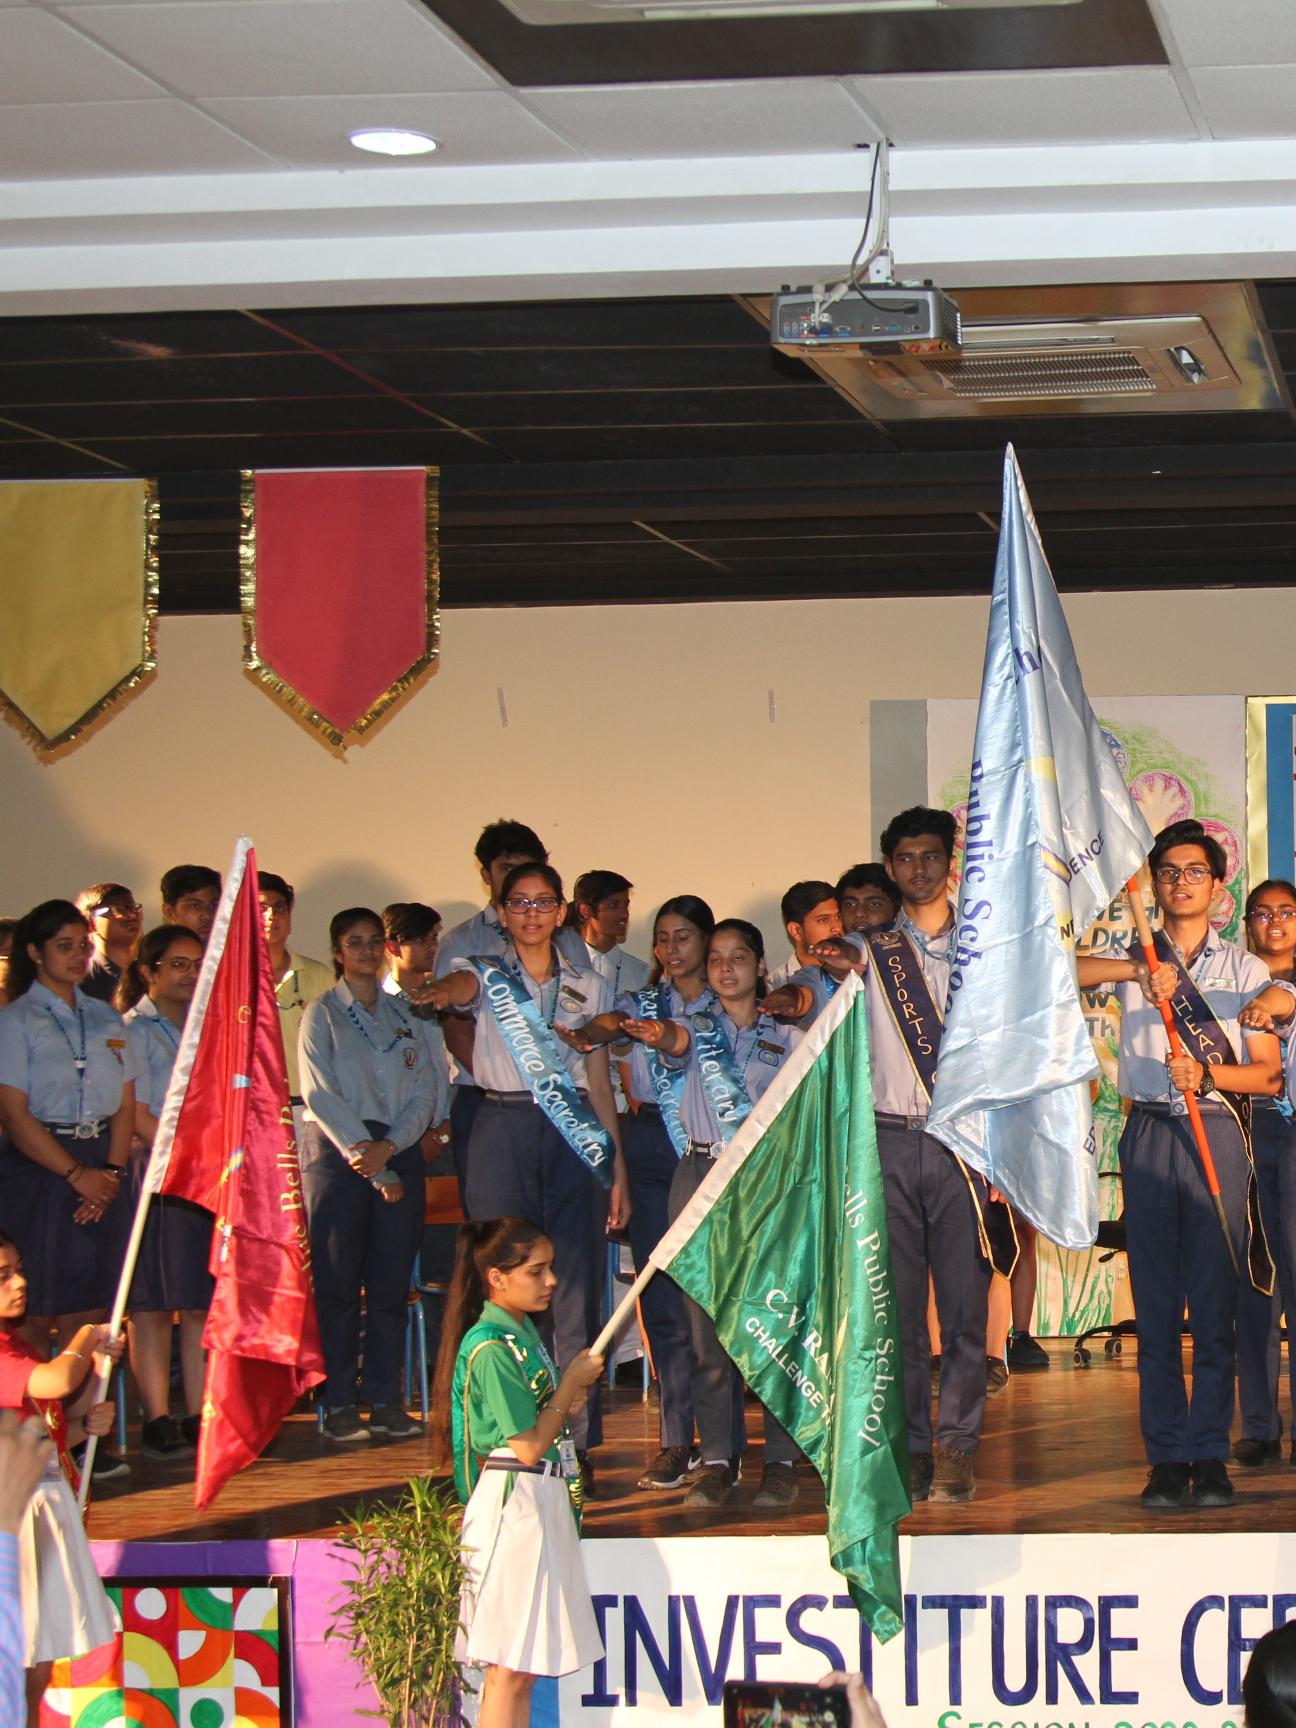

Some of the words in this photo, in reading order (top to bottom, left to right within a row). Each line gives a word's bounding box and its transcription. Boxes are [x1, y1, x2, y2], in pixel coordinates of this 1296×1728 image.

[888, 955, 932, 1055] SPORTS
[1171, 994, 1224, 1066] HEAD
[483, 966, 546, 1073] Commerce
[533, 1072, 609, 1167] Secretary
[276, 1140, 304, 1213] Bells
[855, 1228, 894, 1327] Public
[744, 1317, 824, 1409] CHALLENGE
[857, 1337, 895, 1449] School
[581, 1593, 1140, 1707] INVESTITURE
